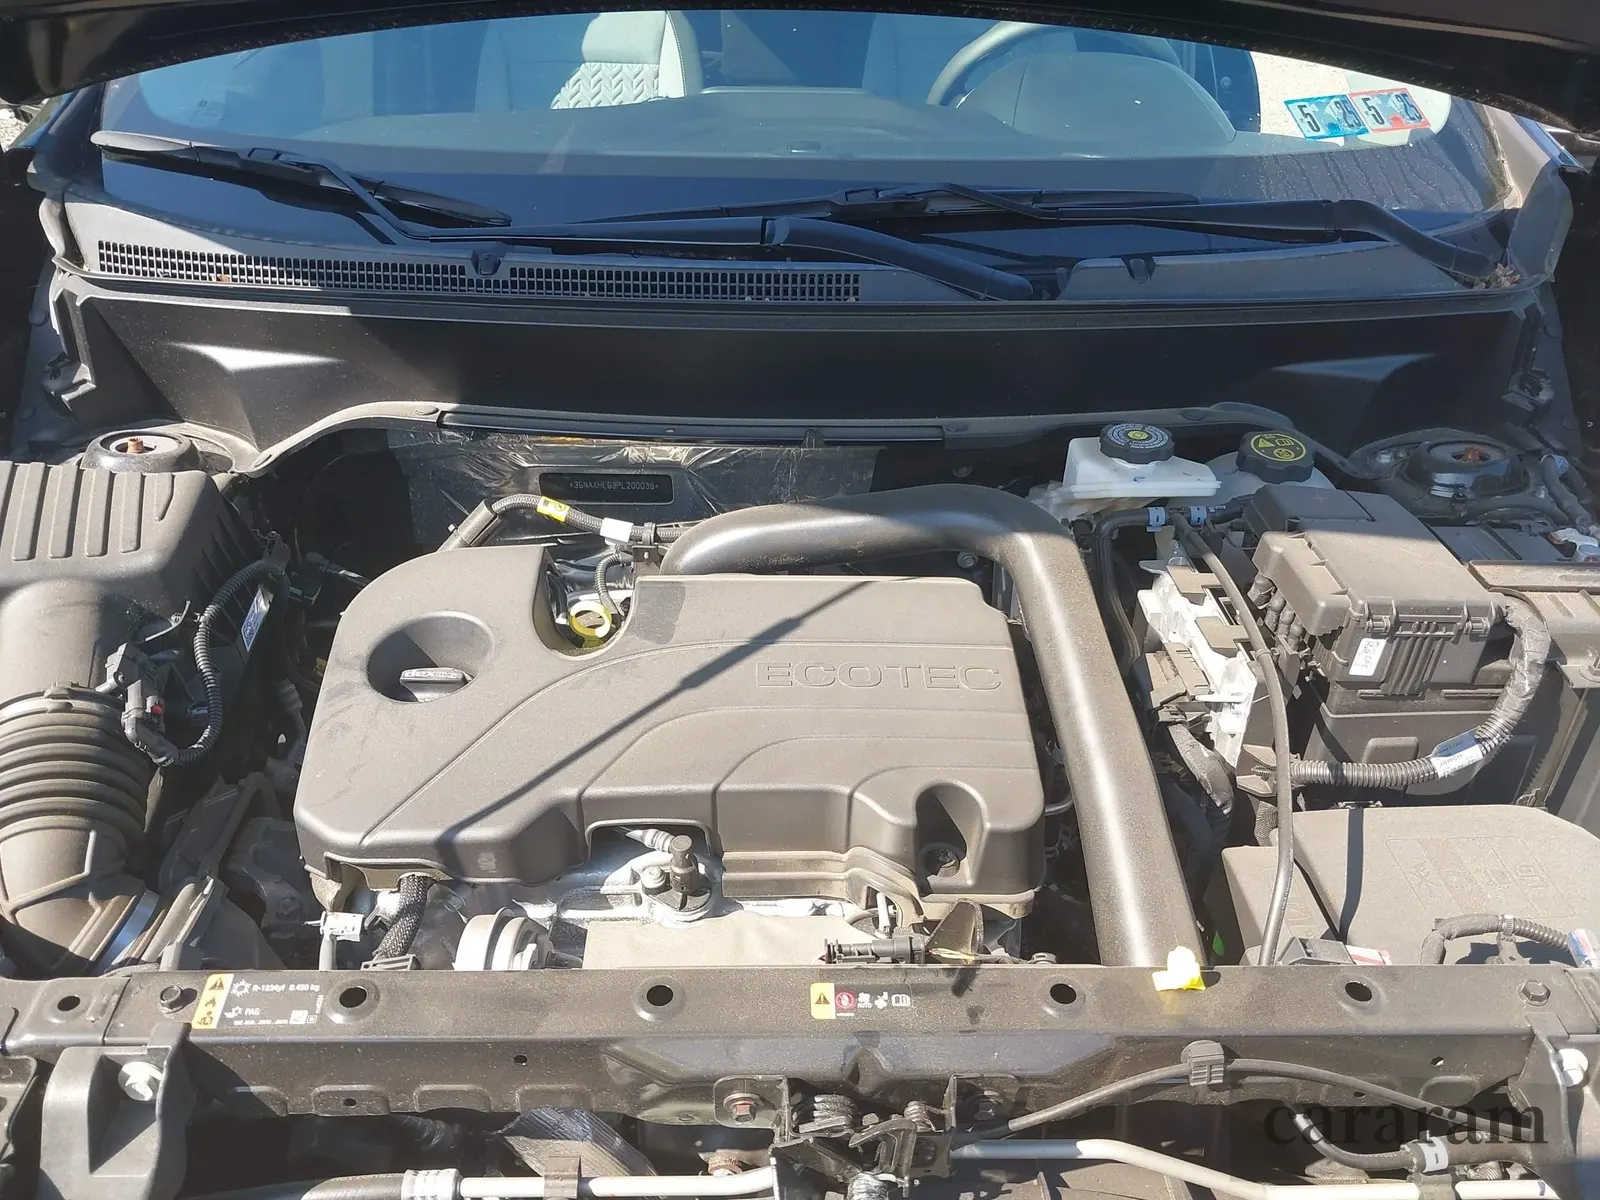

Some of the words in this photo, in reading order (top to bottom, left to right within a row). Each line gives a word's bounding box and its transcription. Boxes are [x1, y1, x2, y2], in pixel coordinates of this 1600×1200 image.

[1297, 104, 1321, 133] 5
[1334, 100, 1362, 128] 25
[1361, 97, 1385, 126] 5
[1395, 93, 1423, 122] 25
[756, 661, 1001, 691] ECOTEC
